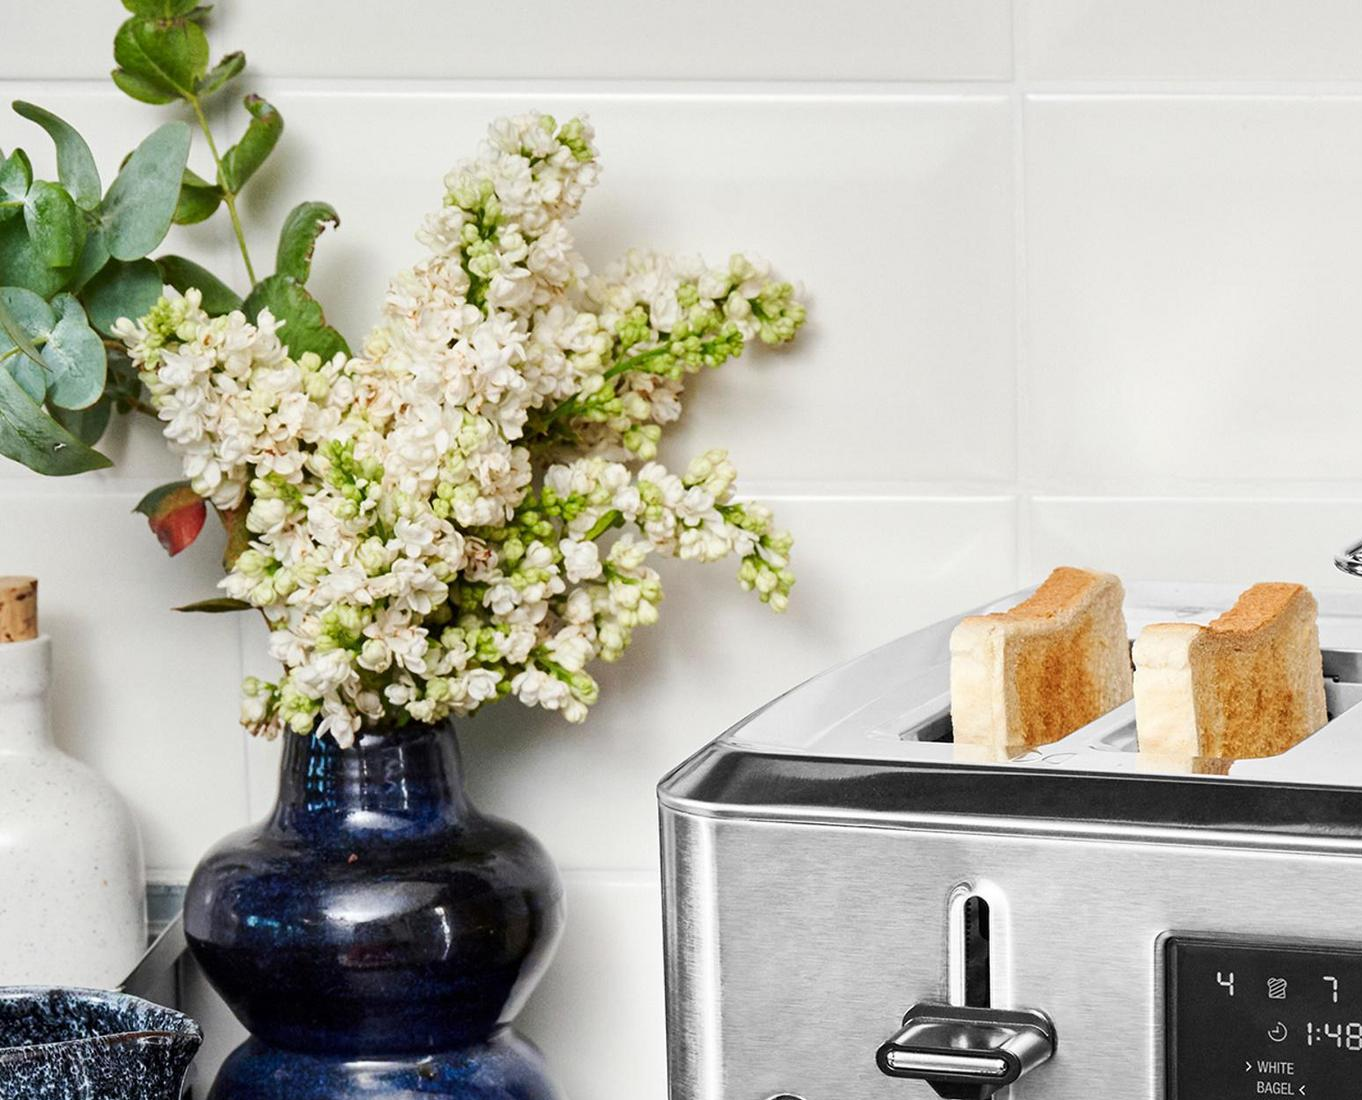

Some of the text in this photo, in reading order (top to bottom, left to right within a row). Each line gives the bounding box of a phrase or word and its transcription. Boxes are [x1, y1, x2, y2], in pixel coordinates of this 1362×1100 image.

[1217, 971, 1234, 996] 4
[1322, 976, 1338, 1003] 7
[1257, 1060, 1295, 1075] WHITE
[1256, 1081, 1295, 1096] BAGEL
